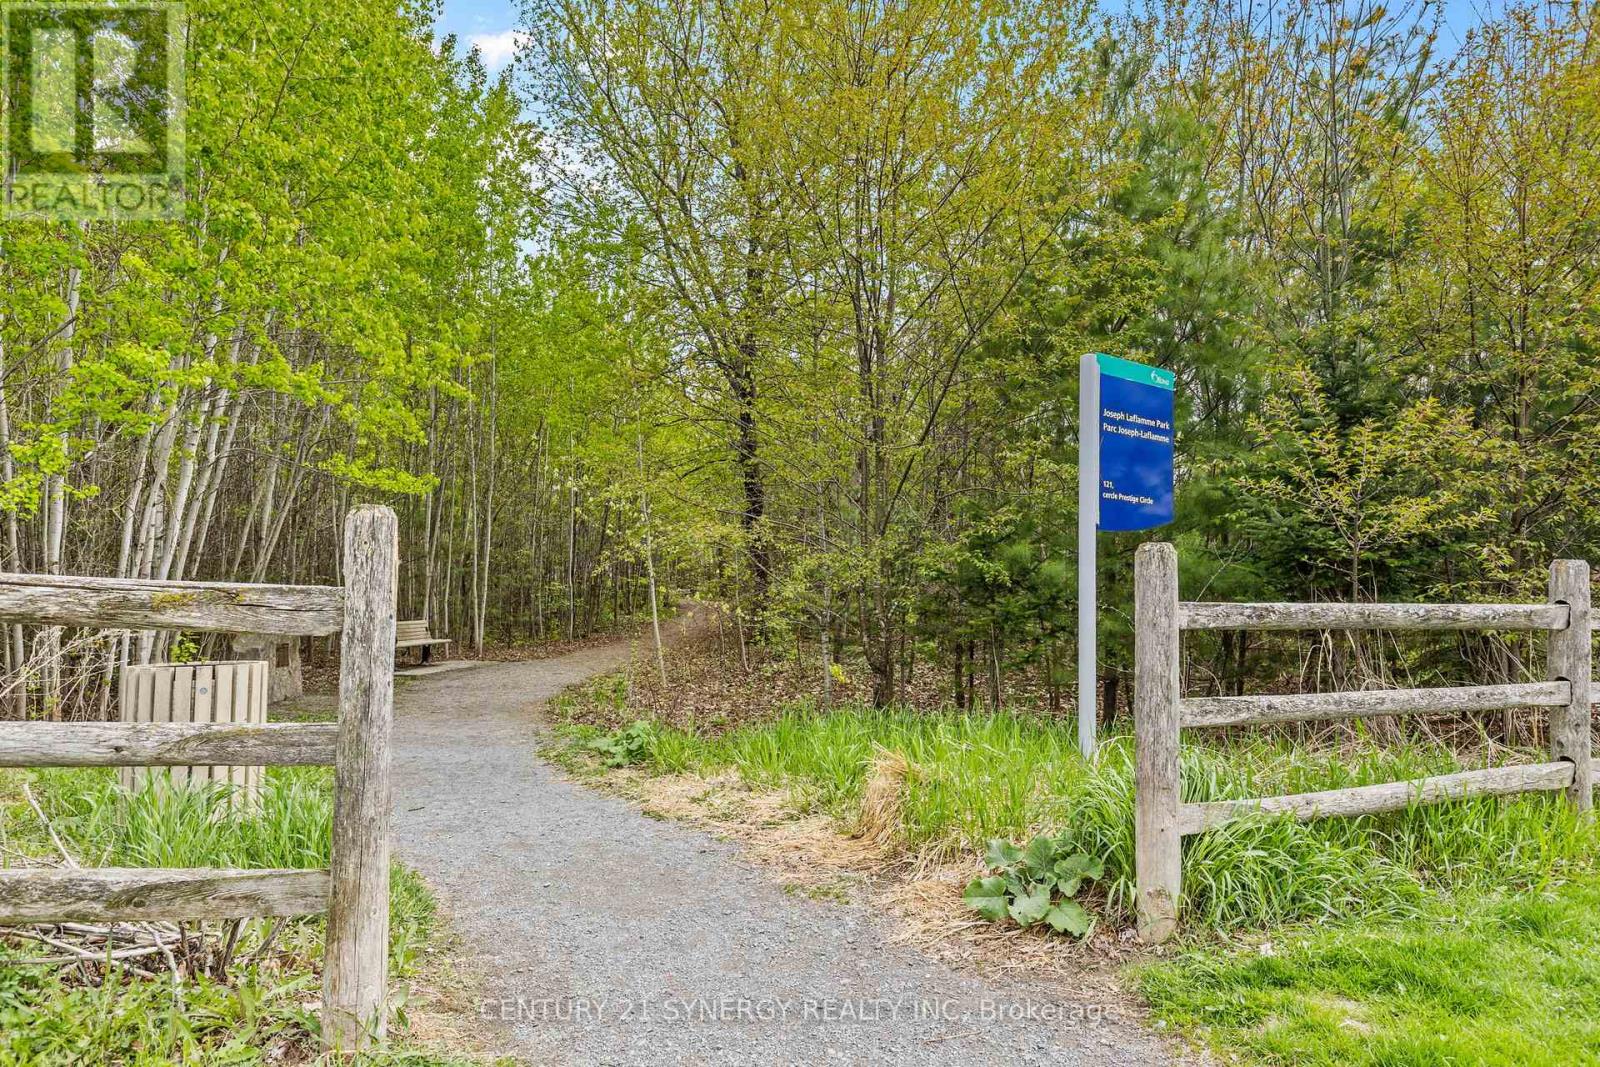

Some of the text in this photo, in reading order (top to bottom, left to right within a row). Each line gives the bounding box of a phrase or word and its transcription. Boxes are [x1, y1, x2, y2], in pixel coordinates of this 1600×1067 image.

[1103, 408, 1170, 430] Joseph Laflamme Park
[1103, 423, 1170, 443] Parc Joseph-Laflamme
[1118, 492, 1139, 504] Prestige
